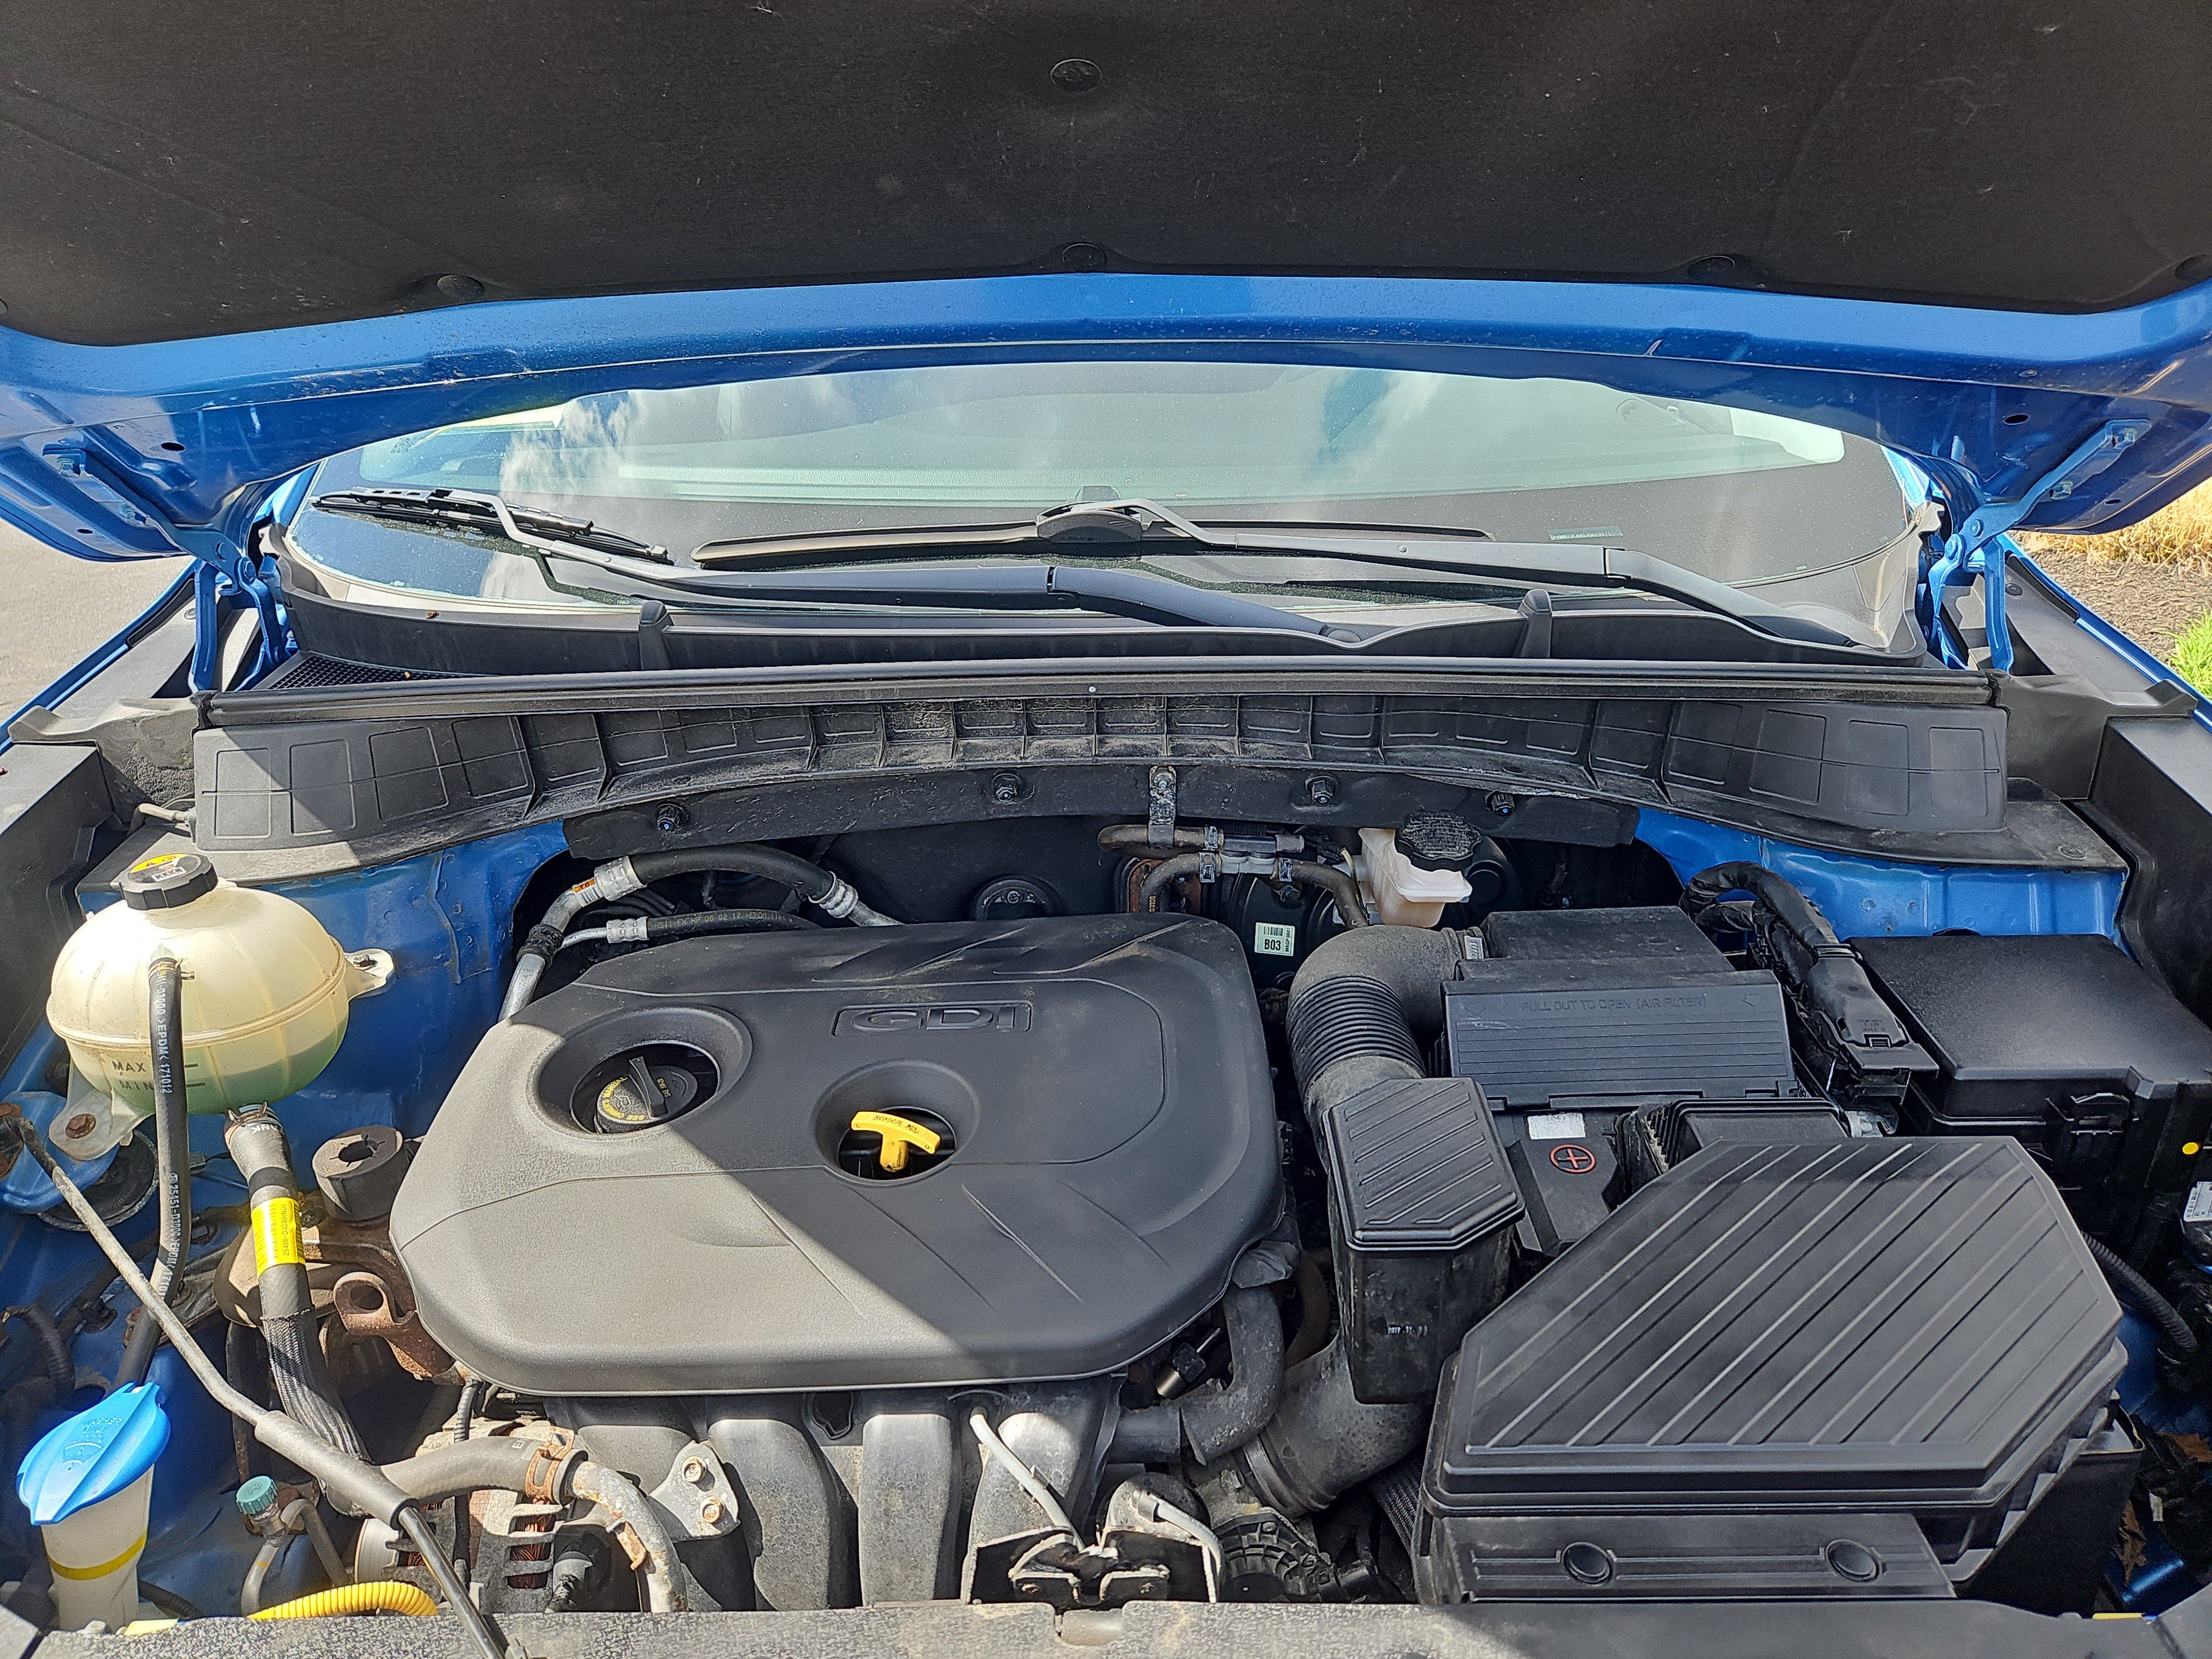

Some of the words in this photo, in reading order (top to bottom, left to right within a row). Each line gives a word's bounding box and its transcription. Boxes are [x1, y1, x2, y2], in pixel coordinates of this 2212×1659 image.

[1264, 938, 1281, 951] B03
[1521, 1001, 1551, 1012] PULL
[1553, 1000, 1577, 1010] OUT
[1580, 1000, 1596, 1009] TO
[1599, 999, 1631, 1009] OPEN
[851, 1006, 1016, 1031] GDI
[112, 1060, 146, 1072] MAX
[119, 1079, 155, 1091] MIN
[160, 1063, 172, 1094] 171012
[872, 1114, 903, 1126] ENGINE
[905, 1124, 918, 1134] OIL
[280, 1204, 290, 1256] 25450-D3200(NU)
[158, 1269, 173, 1301] 17101
